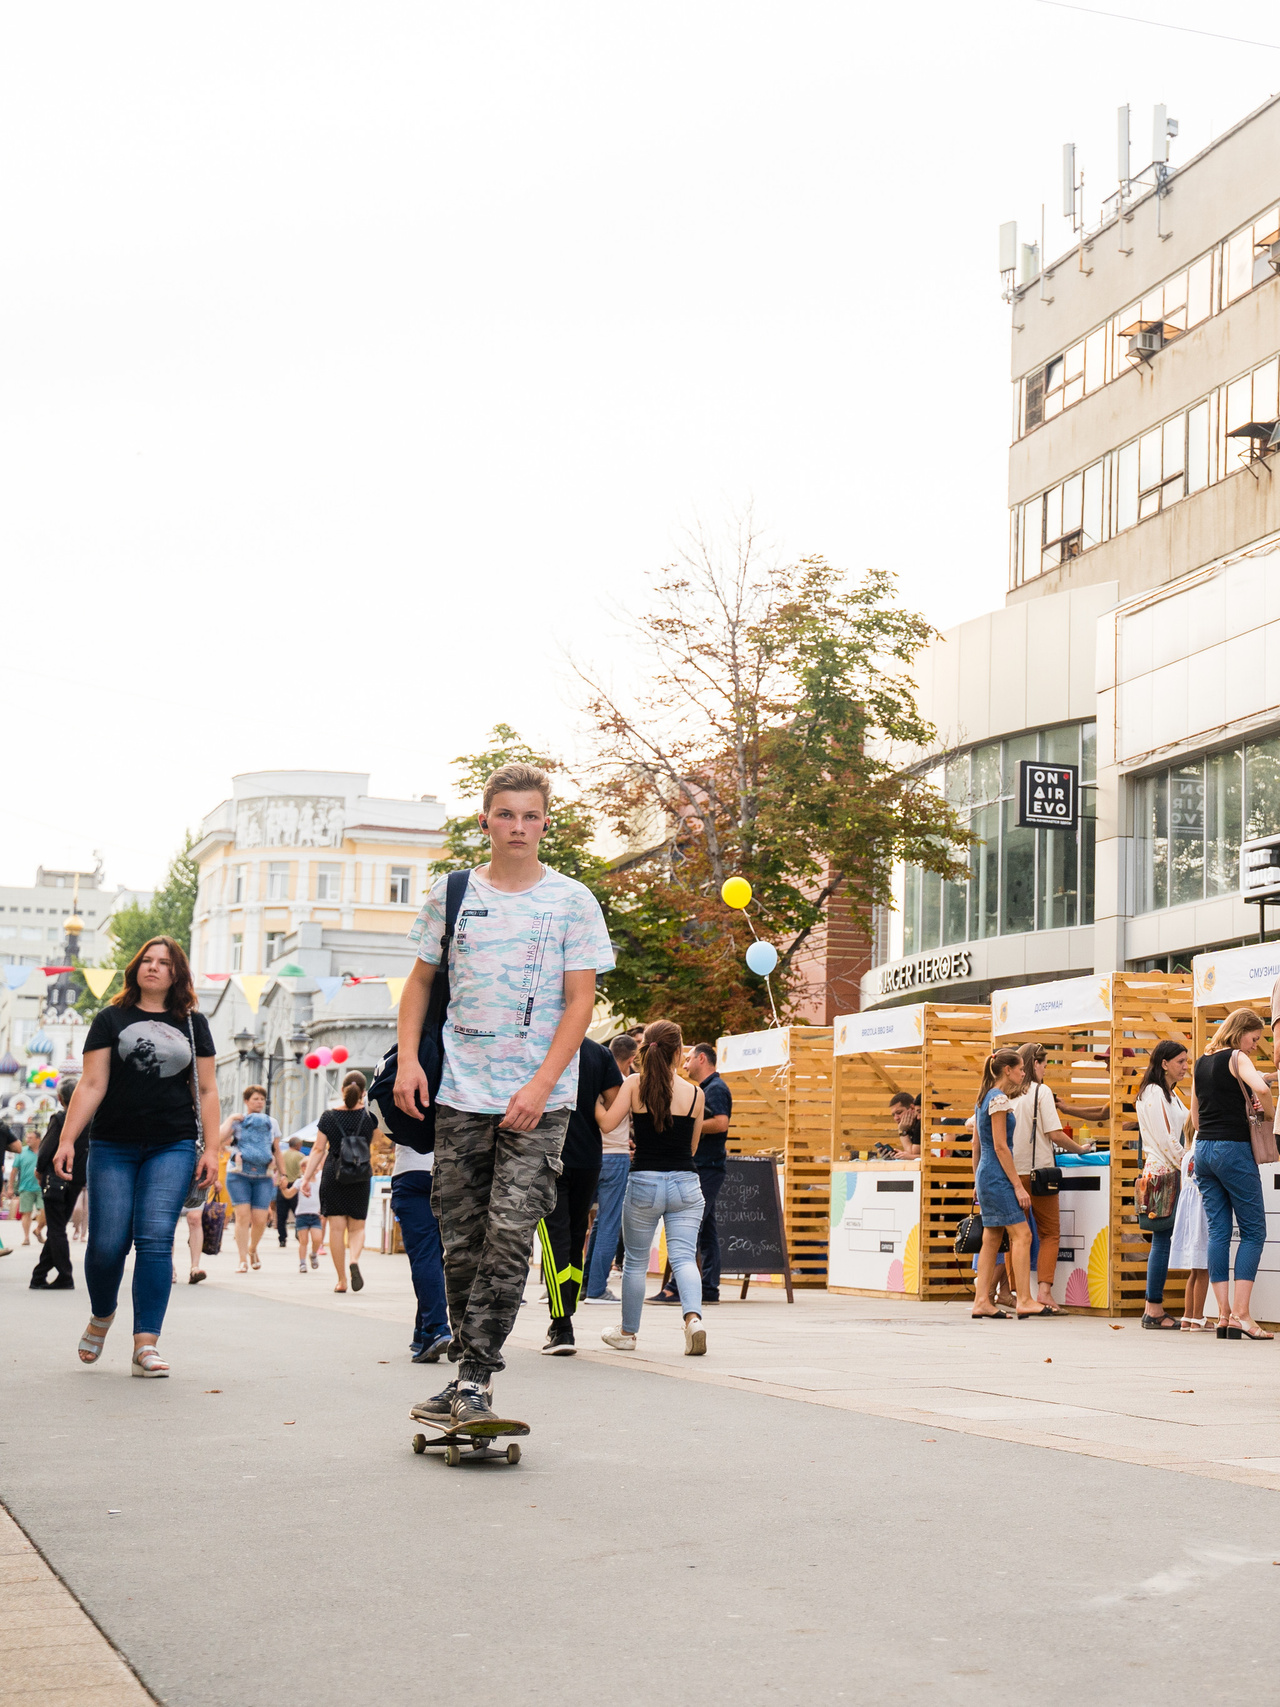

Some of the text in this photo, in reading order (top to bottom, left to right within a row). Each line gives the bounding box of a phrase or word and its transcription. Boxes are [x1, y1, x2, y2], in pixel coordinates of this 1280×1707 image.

[1034, 771, 1059, 785] ON
[1034, 786, 1065, 800] AIR
[1034, 801, 1067, 815] EVO
[531, 911, 542, 936] STORY
[526, 944, 538, 961] HAS
[916, 950, 972, 984] HEROES
[520, 963, 533, 999] SUMMER
[515, 1002, 526, 1026] EVERY
[1034, 1000, 1063, 1013] ДОБЕРМАН
